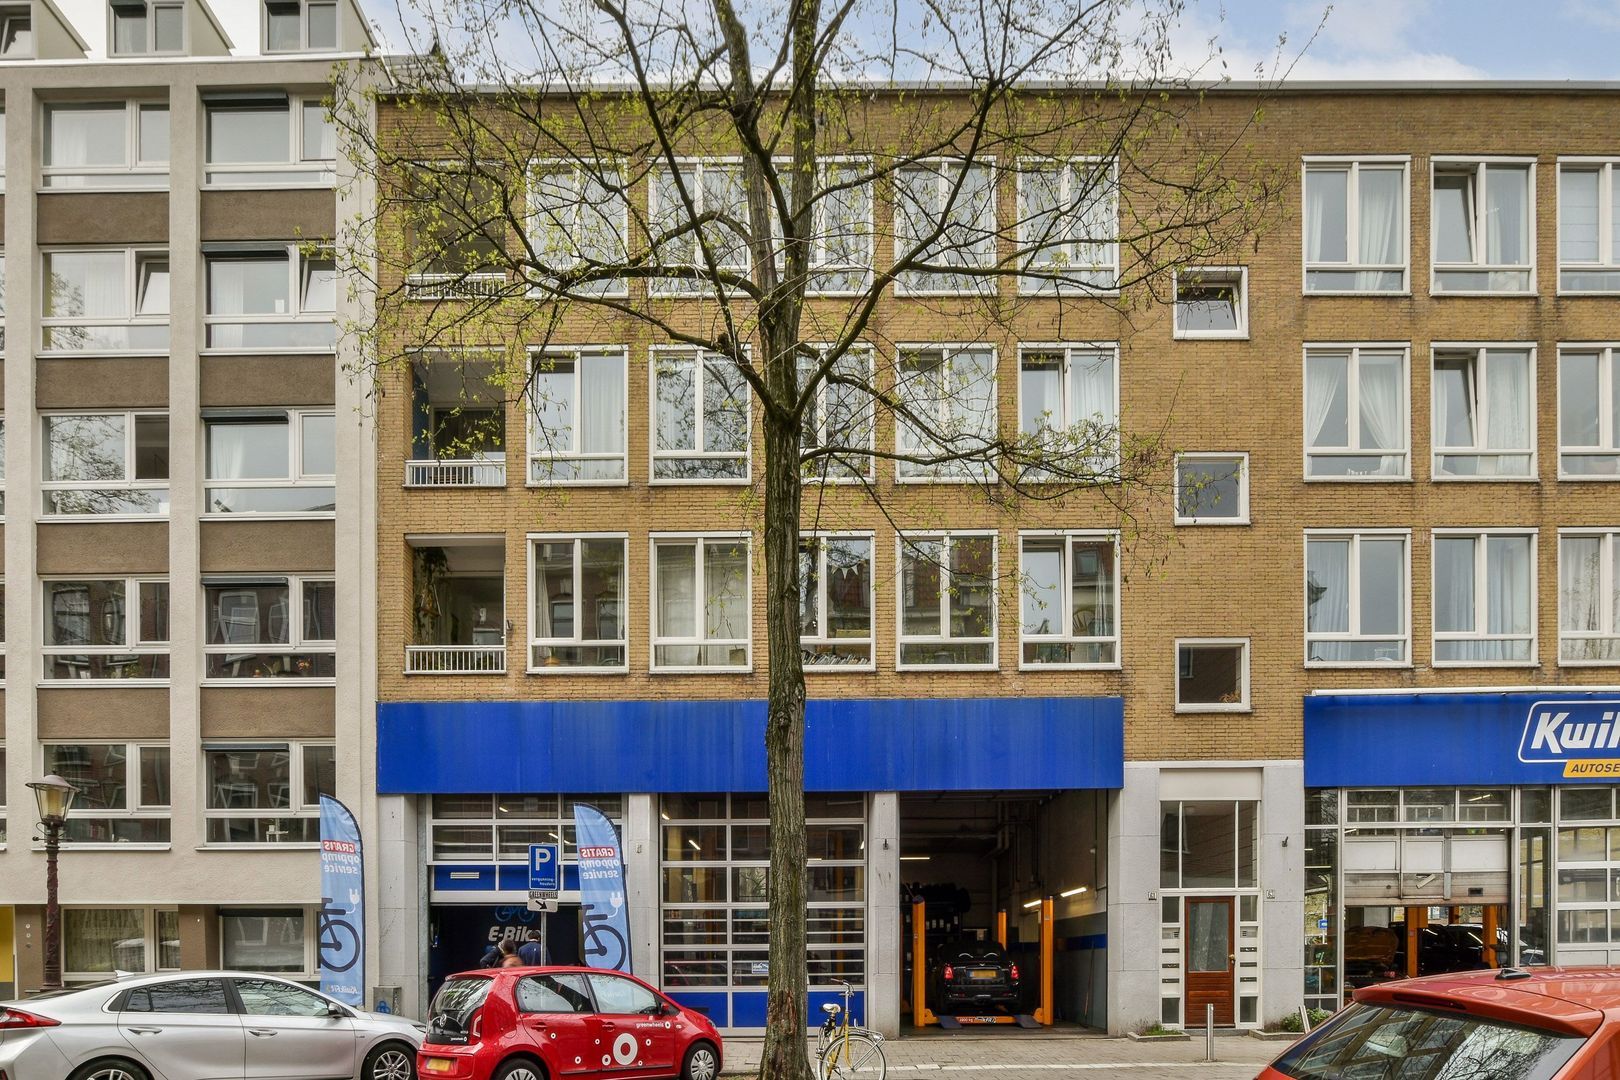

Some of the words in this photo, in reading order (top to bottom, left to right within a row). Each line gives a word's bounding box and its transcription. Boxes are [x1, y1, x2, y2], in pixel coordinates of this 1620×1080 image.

[1571, 763, 1620, 773] AUTOSE
[535, 848, 551, 871] P
[488, 926, 541, 942] E-Bik
